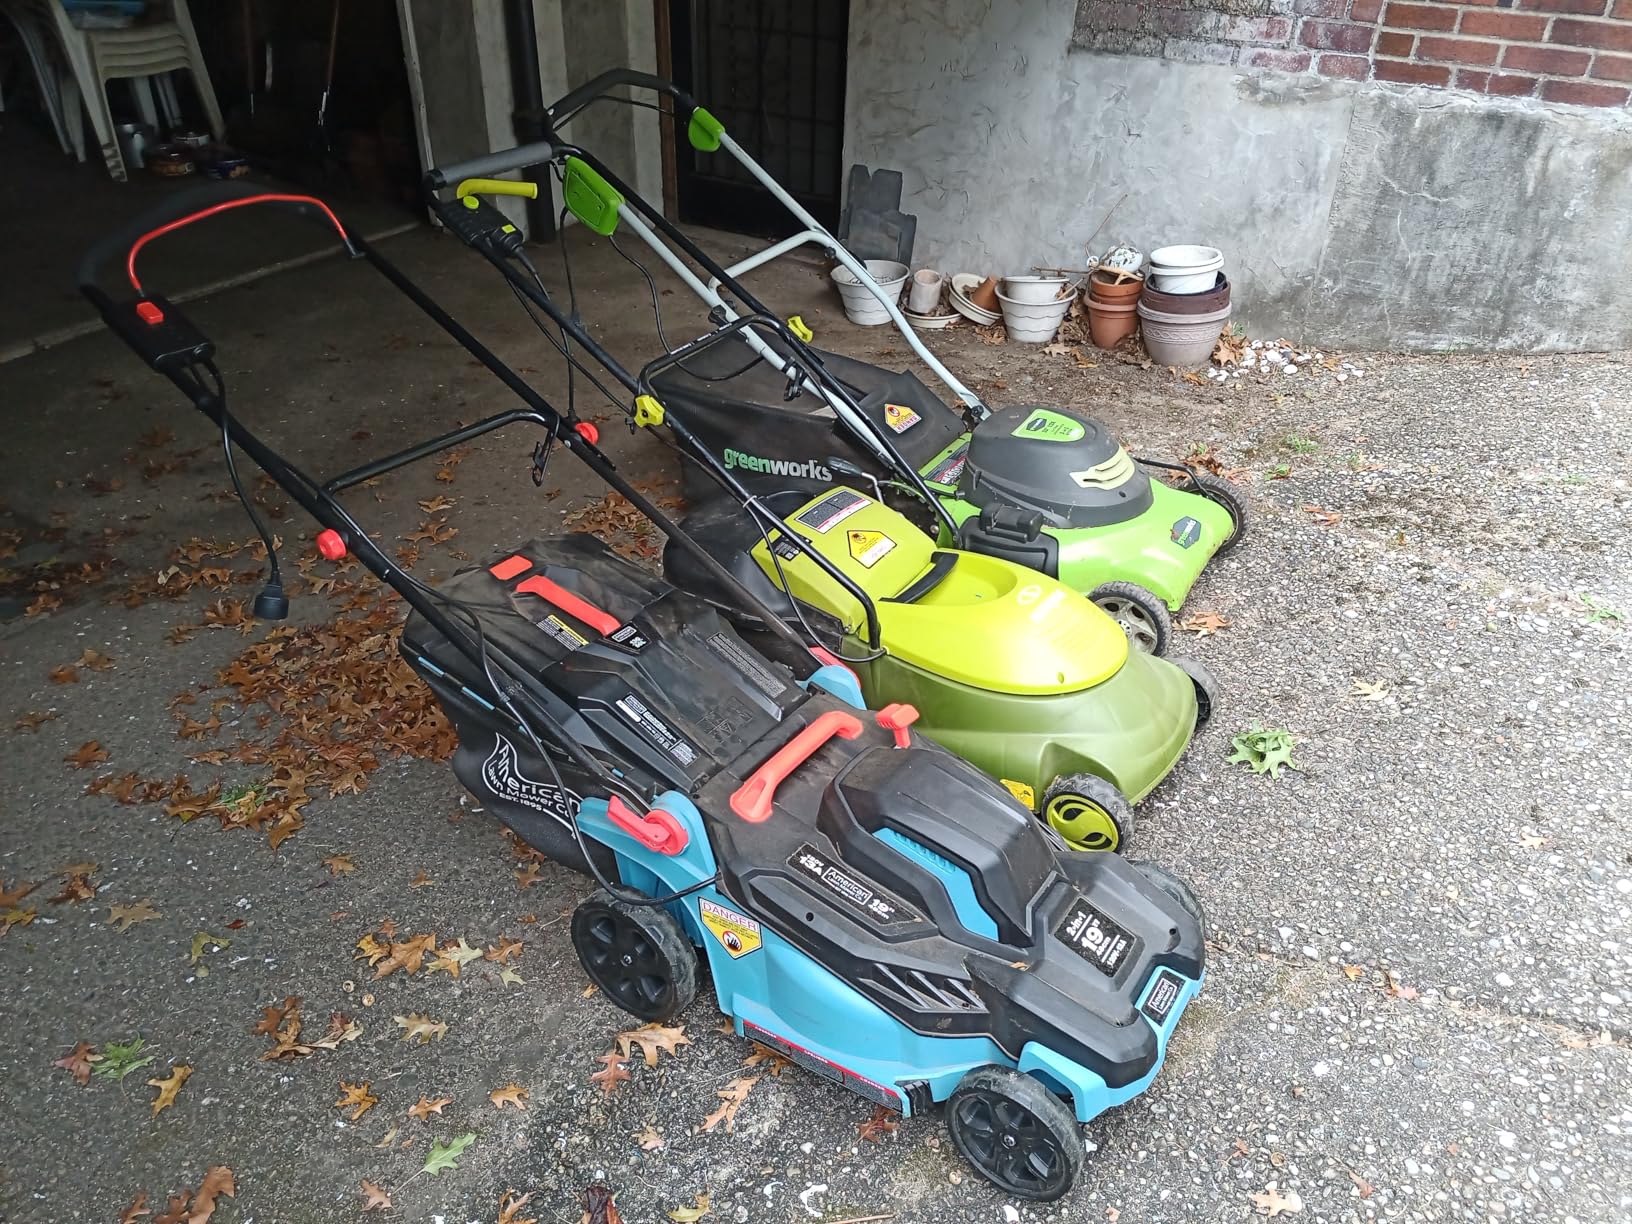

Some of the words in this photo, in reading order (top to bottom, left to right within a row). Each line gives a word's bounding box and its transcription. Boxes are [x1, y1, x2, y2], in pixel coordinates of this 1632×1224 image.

[723, 448, 833, 482] greenworks
[488, 759, 504, 791] Lawn
[506, 787, 554, 807] Mower
[498, 744, 581, 812] American
[799, 856, 823, 876] 13A
[828, 871, 869, 899] American
[703, 902, 757, 931] DANGER
